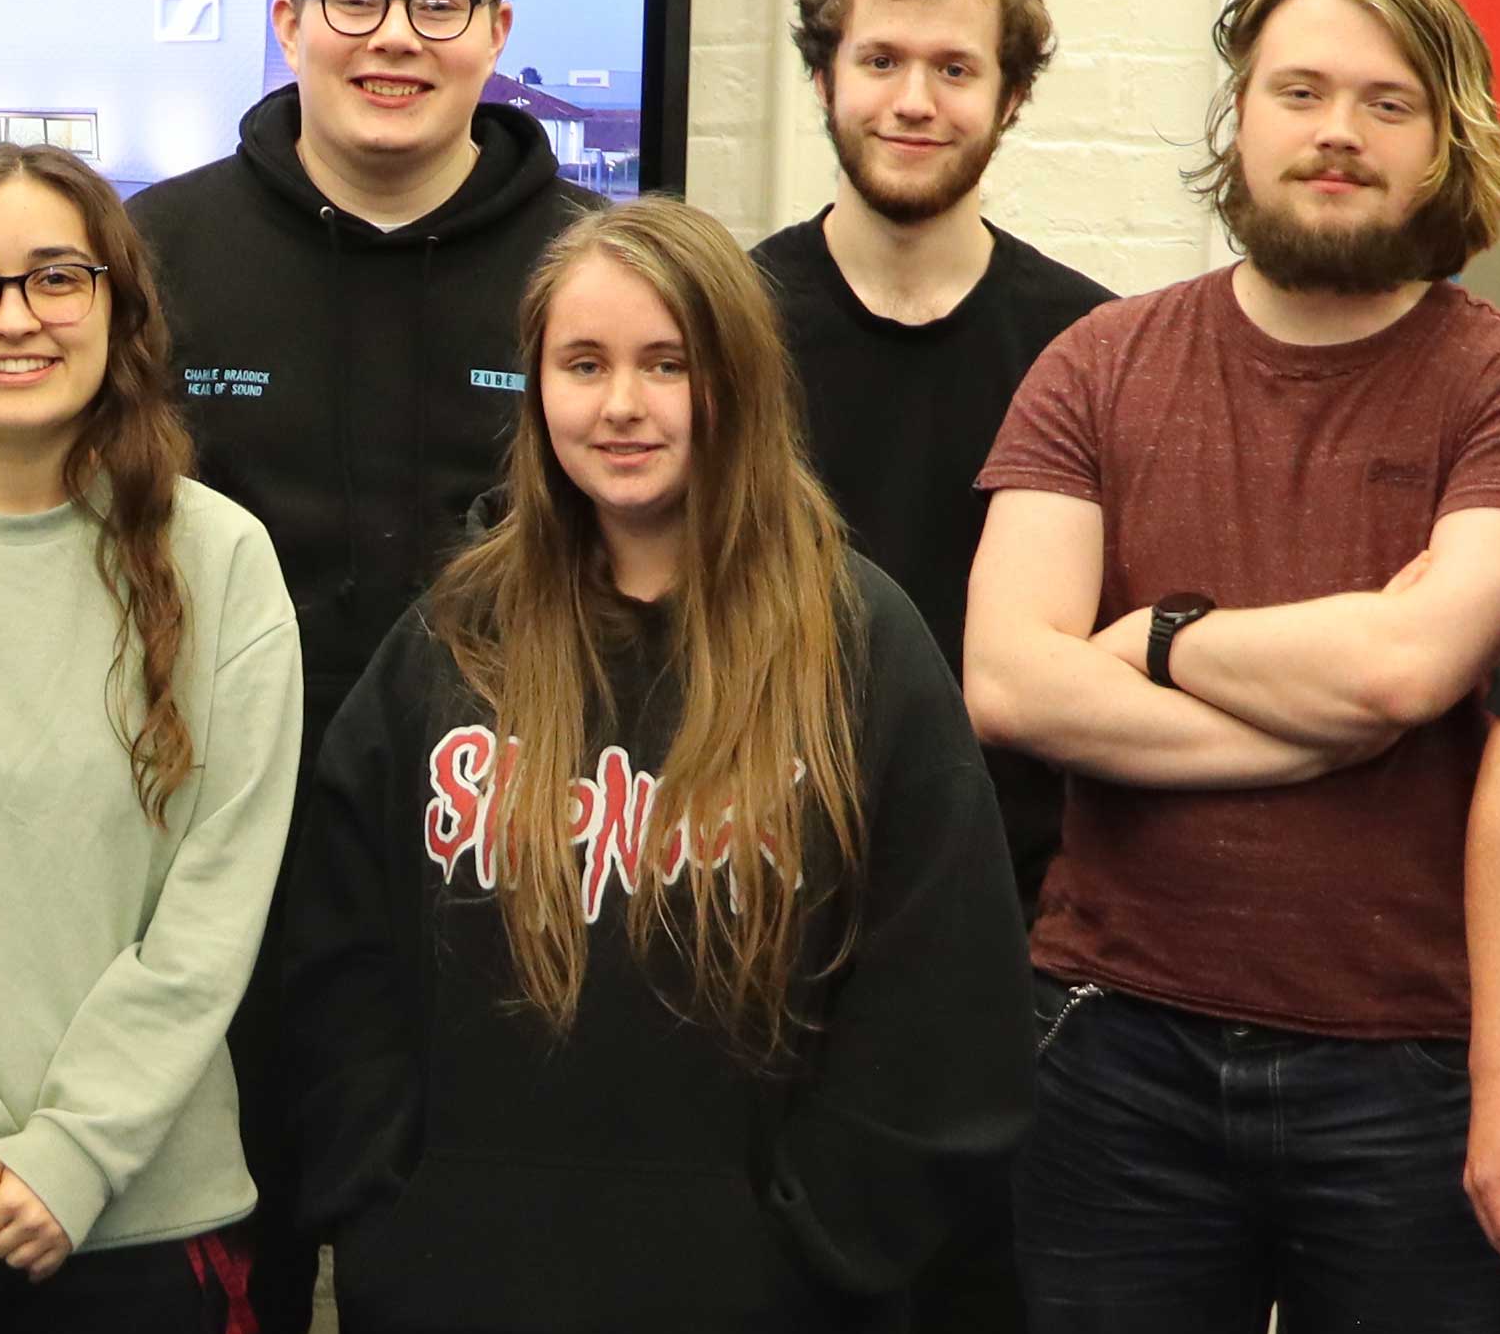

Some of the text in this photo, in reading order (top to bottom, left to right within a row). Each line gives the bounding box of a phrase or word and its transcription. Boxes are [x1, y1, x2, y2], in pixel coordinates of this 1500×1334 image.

[472, 371, 514, 388] 2UBE
[214, 382, 228, 395] OF
[231, 383, 264, 397] SOUND
